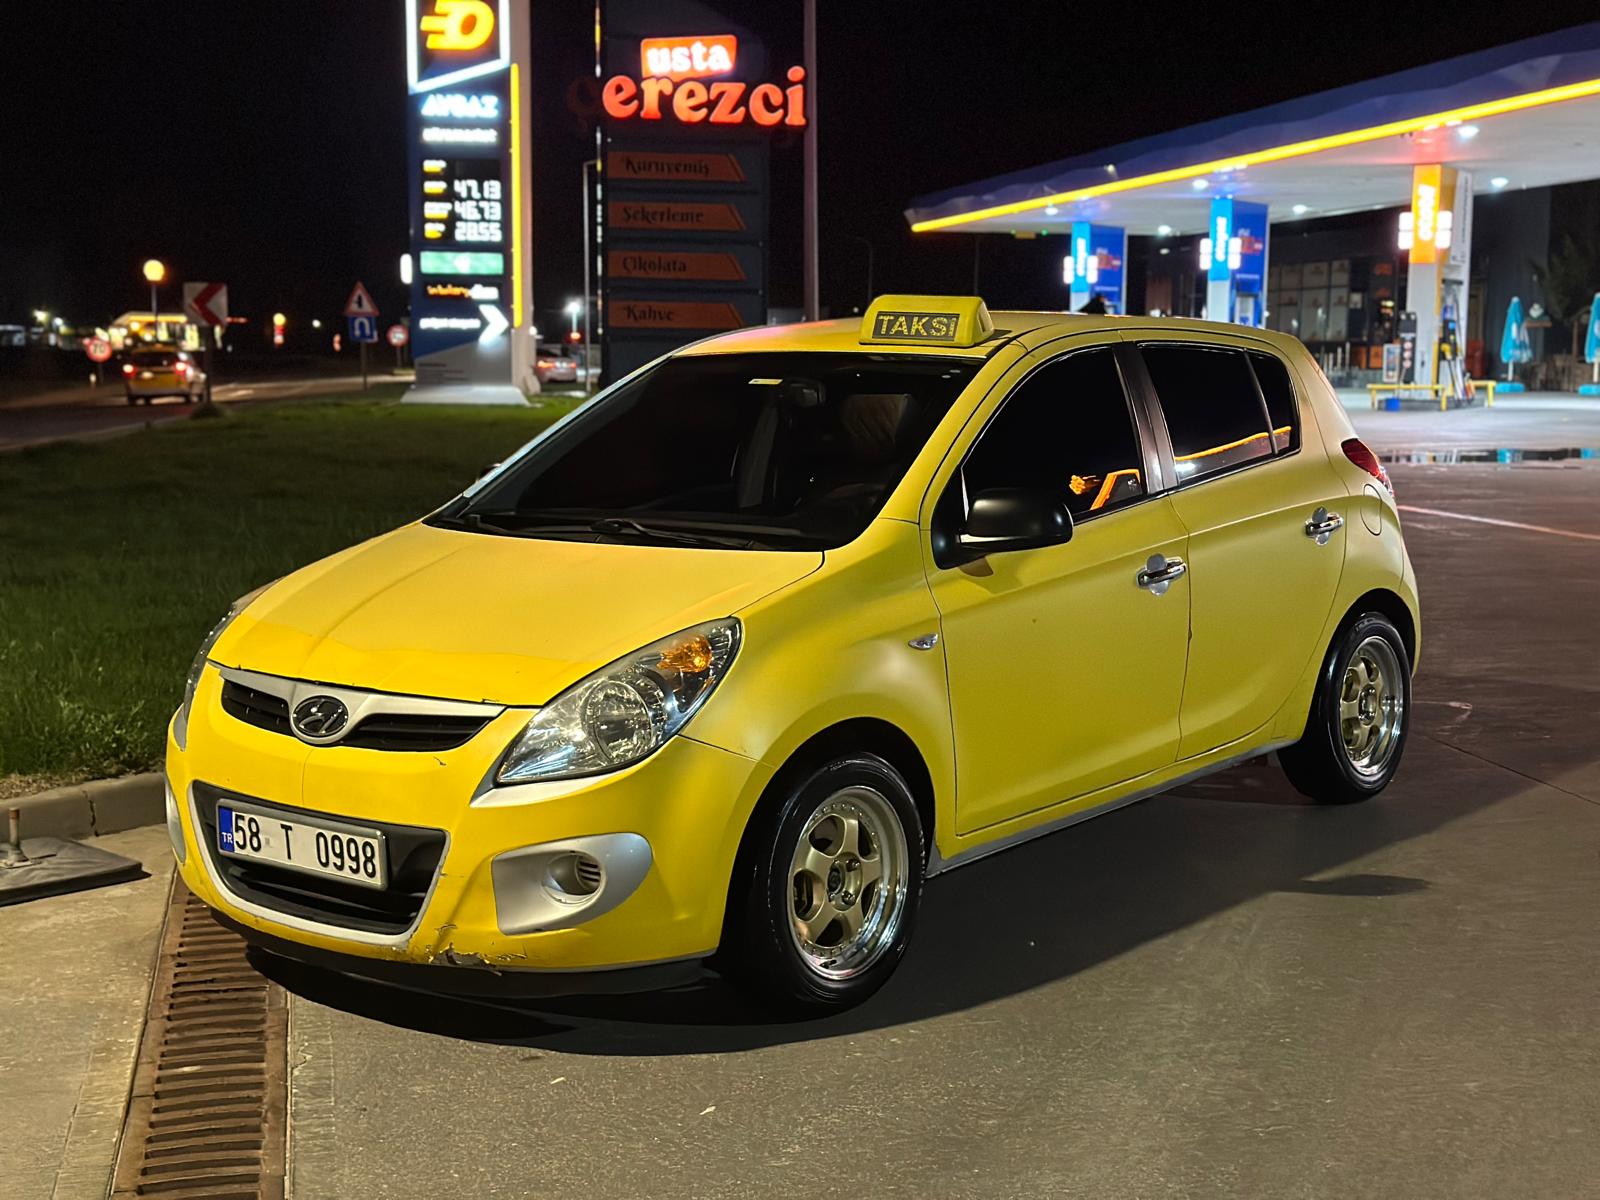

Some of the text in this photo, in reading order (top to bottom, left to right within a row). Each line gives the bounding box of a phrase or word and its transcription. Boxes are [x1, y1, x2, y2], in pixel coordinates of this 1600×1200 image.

[645, 40, 733, 74] usta
[567, 66, 807, 126] erezci
[625, 305, 674, 321] Kahve
[221, 831, 234, 844] TR
[234, 813, 377, 878] 58 T 0998
